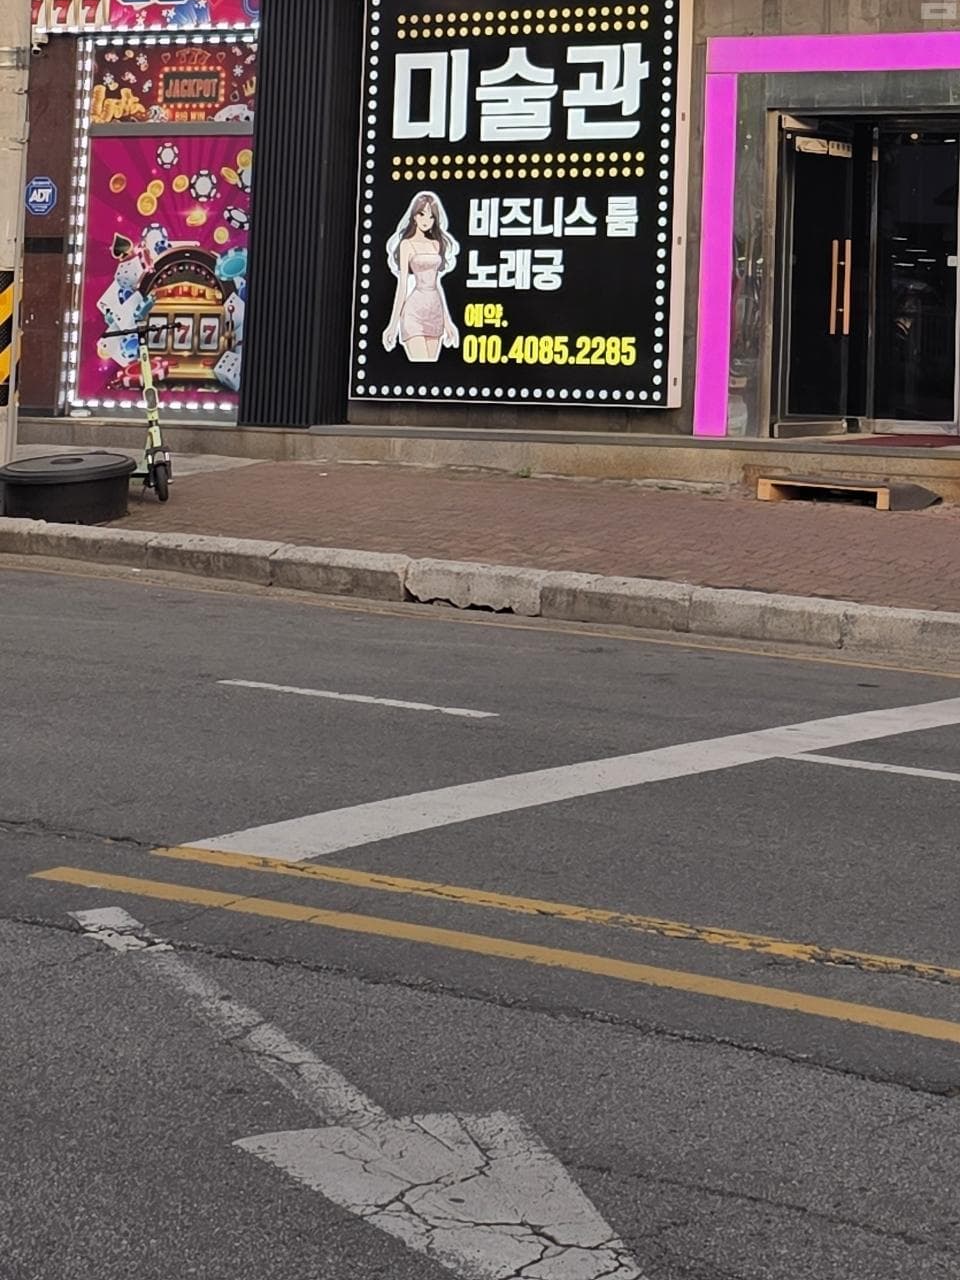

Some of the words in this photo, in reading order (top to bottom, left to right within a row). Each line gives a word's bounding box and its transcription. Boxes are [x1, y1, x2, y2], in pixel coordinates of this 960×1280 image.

[165, 77, 218, 98] JACKPOT
[392, 42, 650, 143] 미술관
[29, 188, 53, 202] ADT
[468, 196, 598, 238] 비즈니스
[605, 195, 639, 238] 룸
[466, 249, 565, 291] 노래궁
[462, 334, 637, 366] 010.4085.2285
